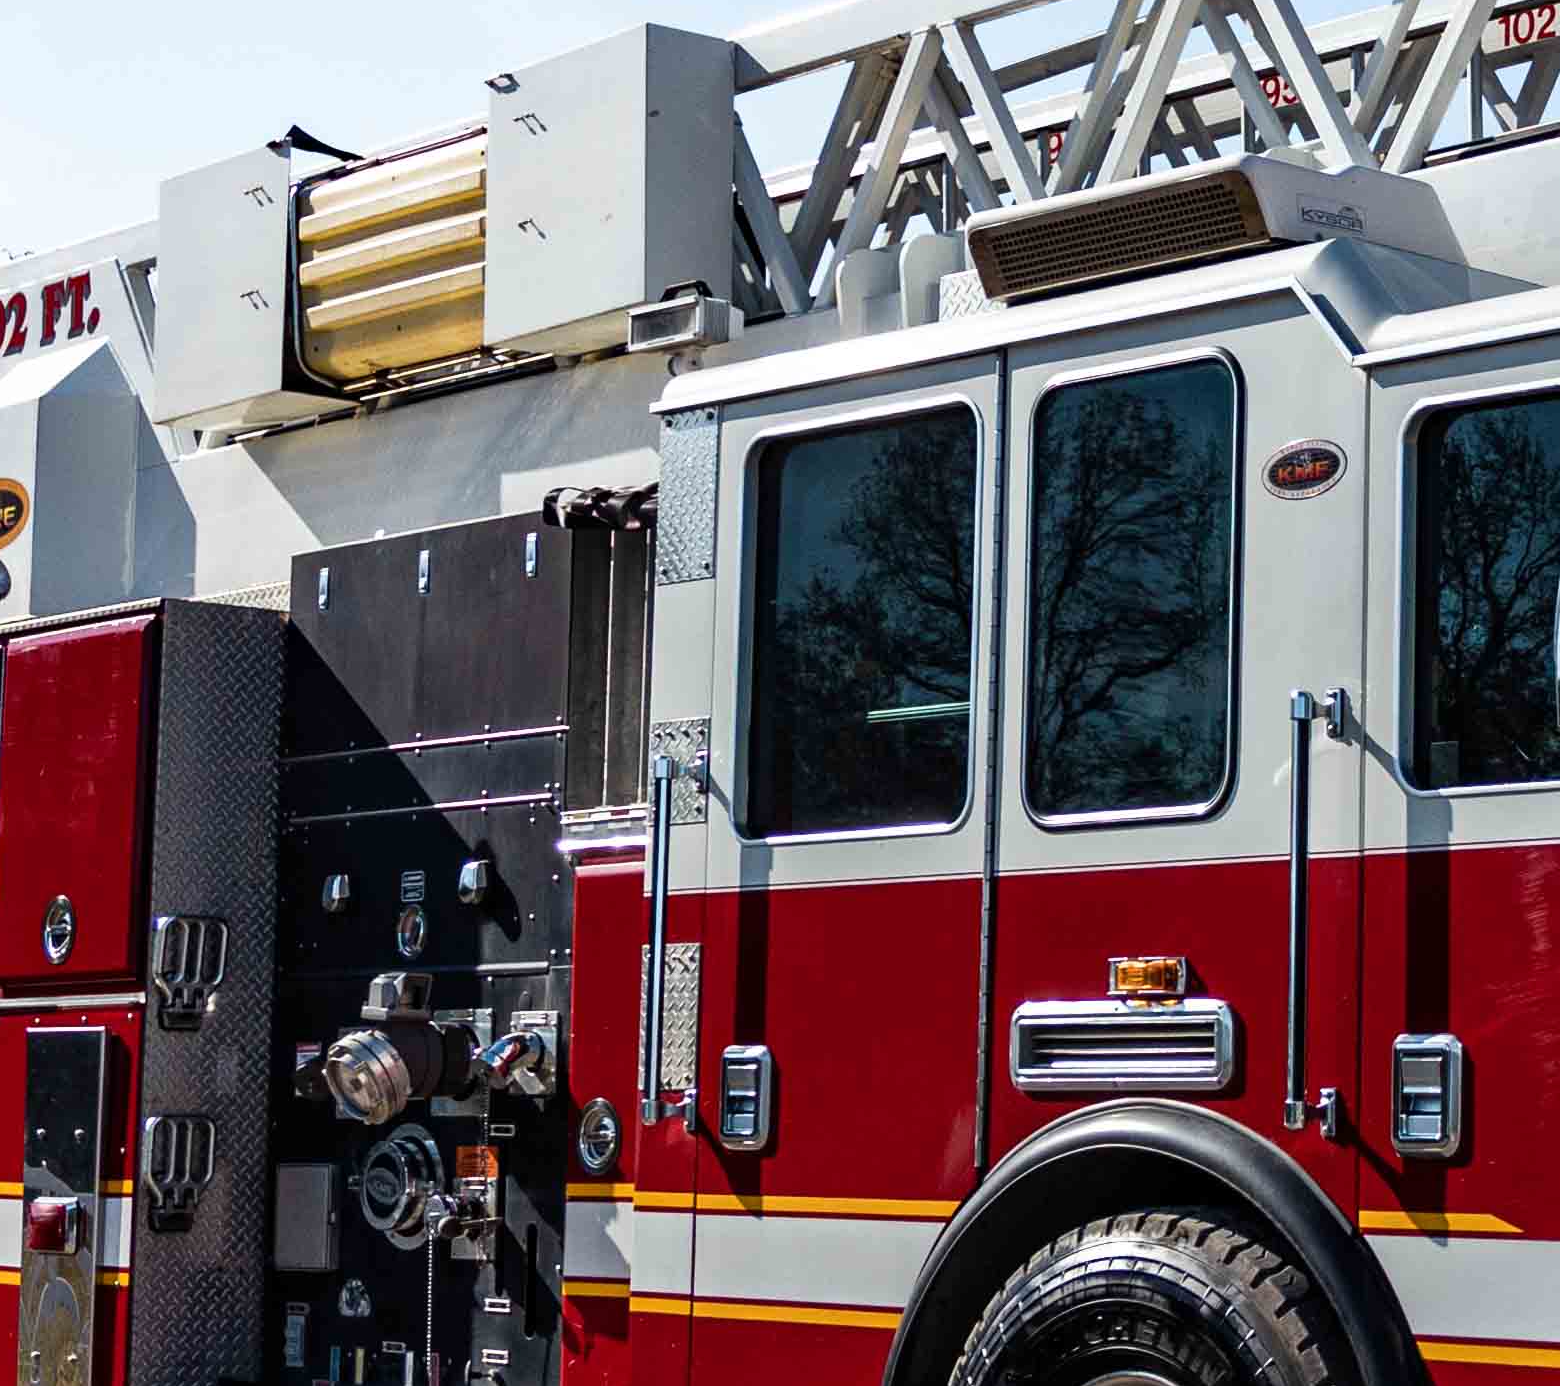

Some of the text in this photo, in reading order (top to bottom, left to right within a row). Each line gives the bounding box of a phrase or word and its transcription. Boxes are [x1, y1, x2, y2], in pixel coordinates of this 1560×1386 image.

[1498, 4, 1557, 47] 102
[39, 269, 101, 348] FT.
[1277, 460, 1329, 485] KME
